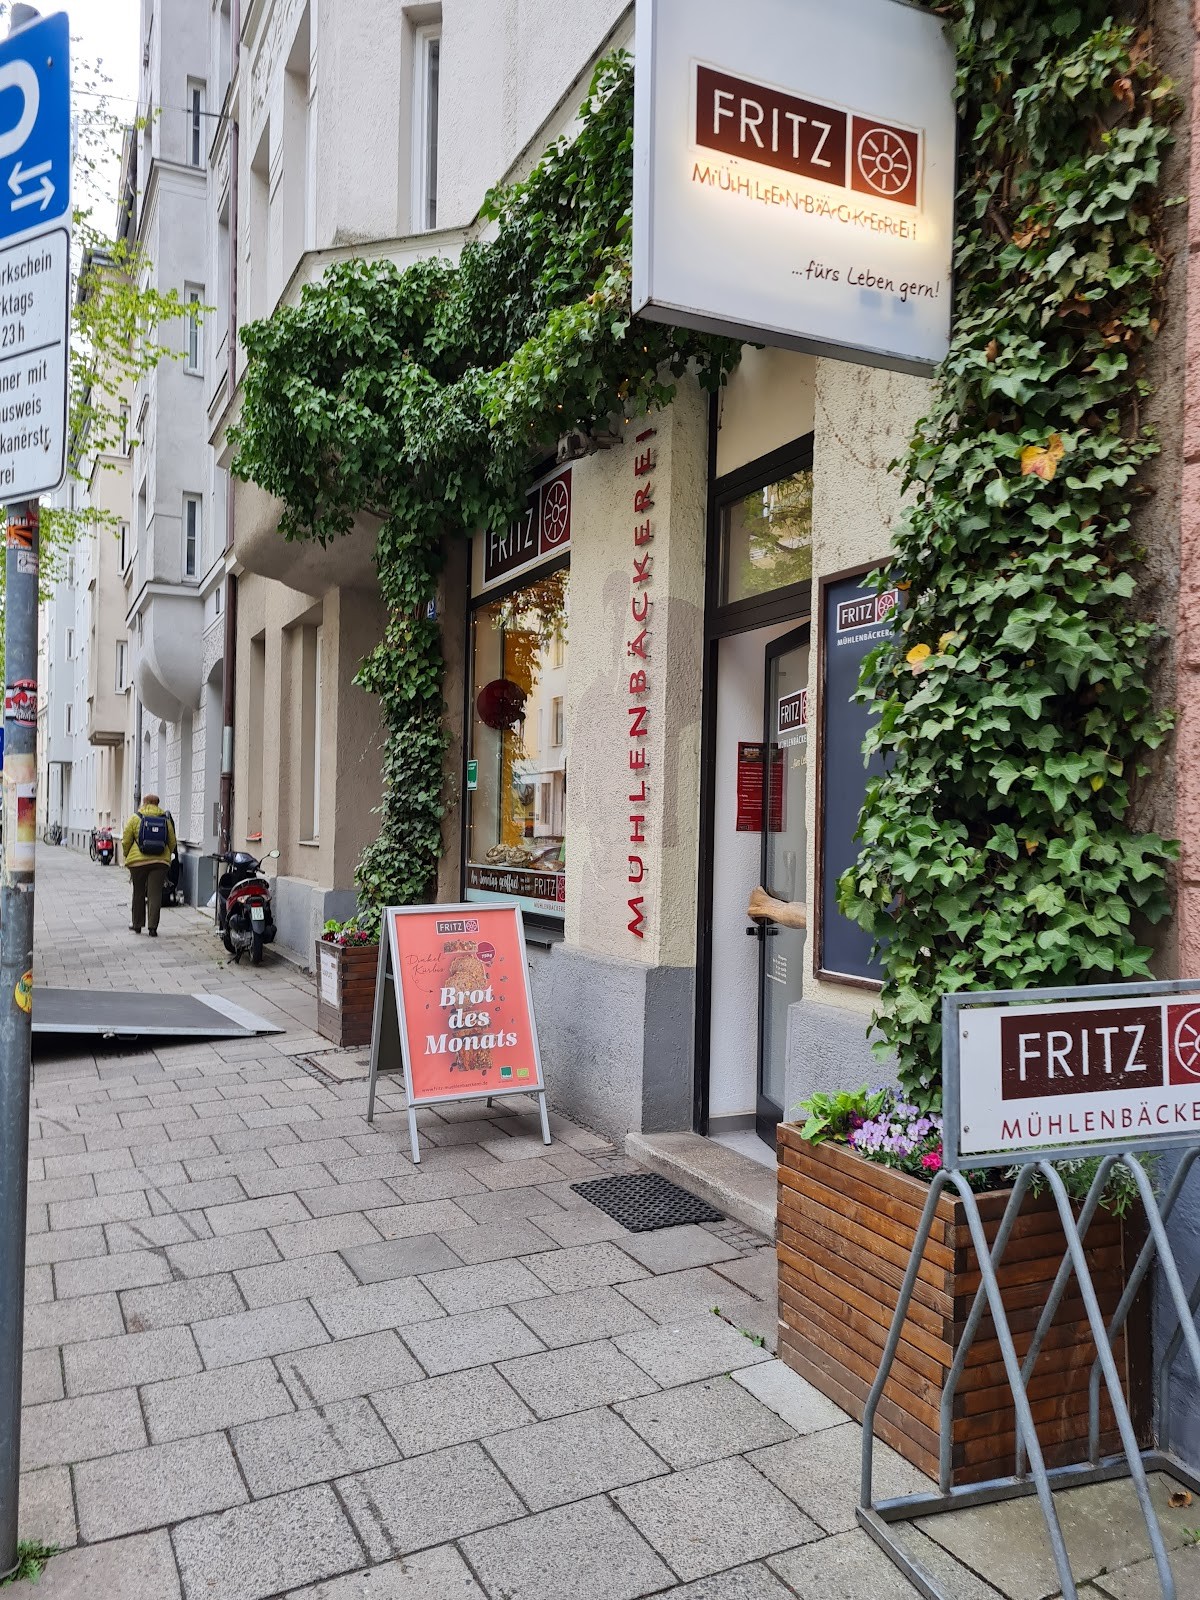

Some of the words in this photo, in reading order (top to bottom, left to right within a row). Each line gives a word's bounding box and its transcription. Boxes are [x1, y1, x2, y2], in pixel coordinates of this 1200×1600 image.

[713, 87, 833, 168] FRITZ
[692, 159, 917, 240] MÜHLENBÄCKEREI
[0, 249, 52, 287] rkschein
[791, 260, 840, 283] ...fürs
[847, 266, 895, 292] Leben
[899, 280, 940, 302] gern!
[0, 291, 34, 317] ktags
[0, 371, 21, 393] ner
[28, 359, 48, 386] mit
[0, 393, 42, 423] usweis
[841, 602, 873, 625] FRITZ
[780, 700, 800, 725] FRITZ
[534, 877, 556, 897] FRITZ
[440, 922, 463, 932] FRITZ
[439, 984, 495, 1007] Brot
[448, 1008, 491, 1030] des
[424, 1030, 518, 1055] Monats
[1018, 1024, 1148, 1081] FRITZ
[1001, 1101, 1200, 1141] MÜHLENBÄCKE
